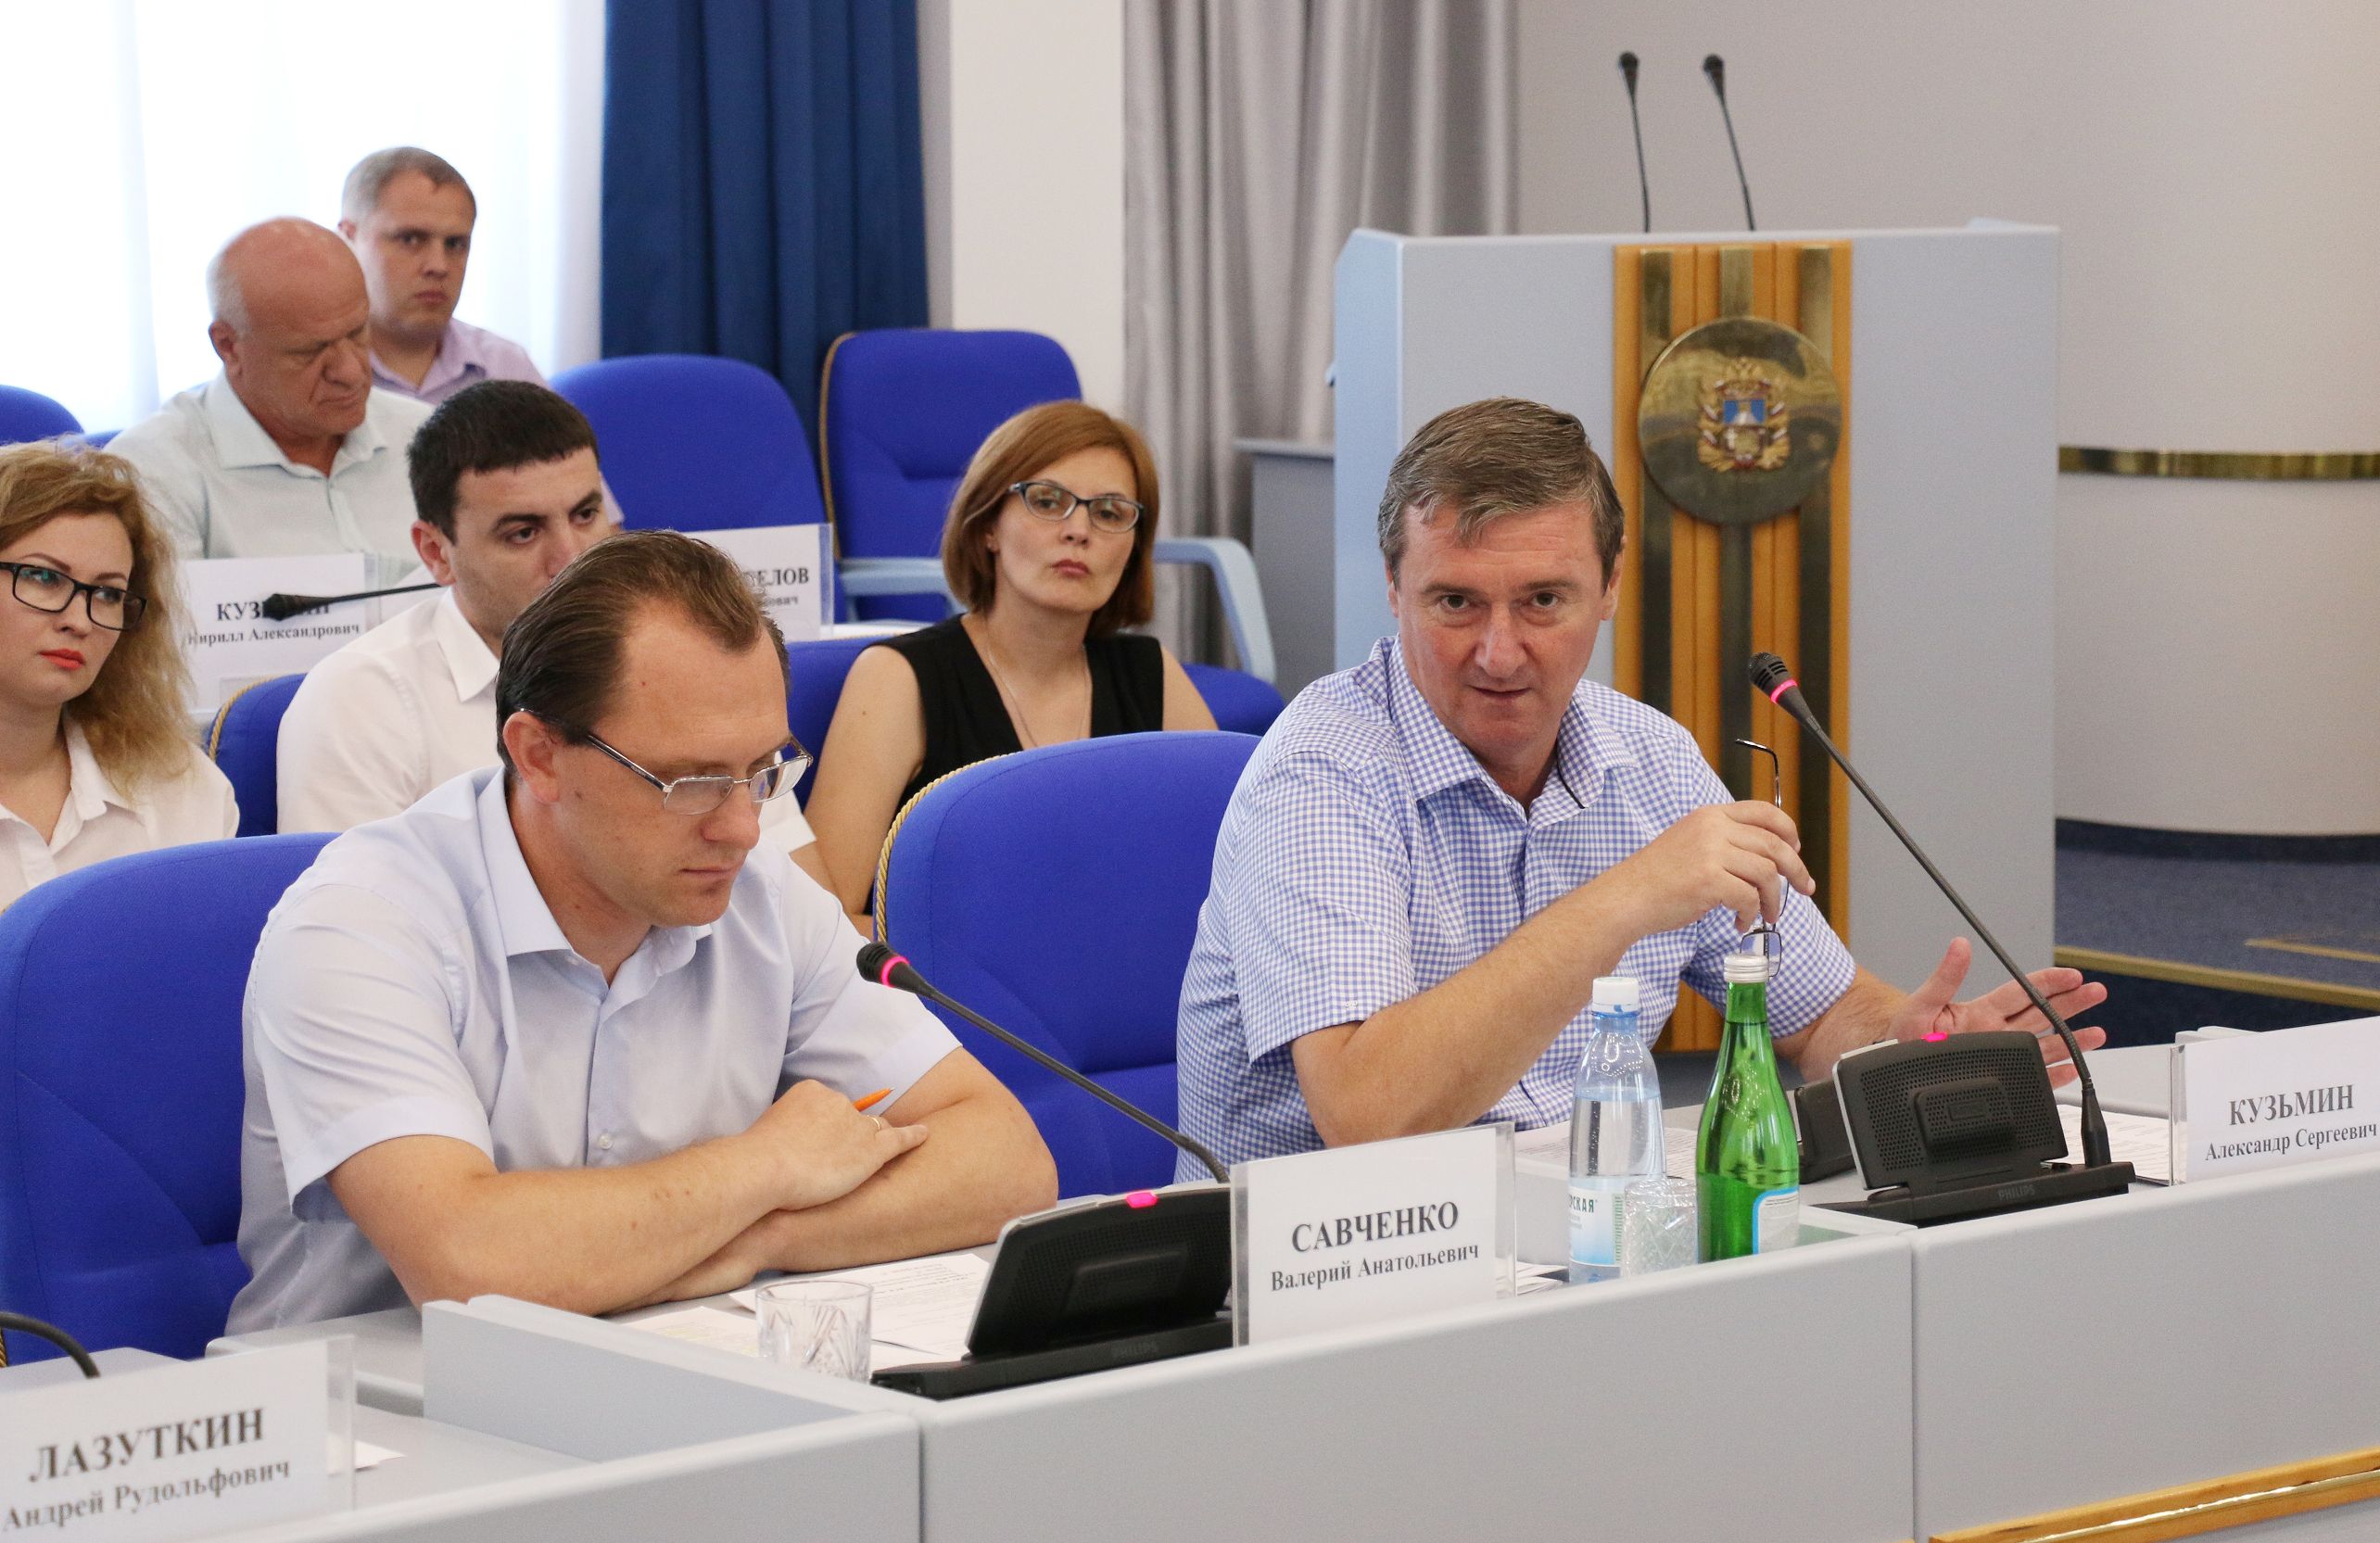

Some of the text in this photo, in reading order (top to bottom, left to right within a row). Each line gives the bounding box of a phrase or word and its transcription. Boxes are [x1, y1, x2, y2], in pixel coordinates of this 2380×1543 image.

[744, 567, 809, 586] ЕЛОВ
[248, 624, 360, 640] Александрович
[2229, 1084, 2354, 1126] КУЗЬМИН
[2205, 1123, 2377, 1160] Александр Сергеевич
[1291, 1201, 1460, 1253] САВЧЕНКО
[1271, 1245, 1479, 1291] Валерий Анатольевич
[29, 1408, 266, 1482] ЛАЗУТКИН
[3, 1460, 291, 1532] Андрей Рудольфович
